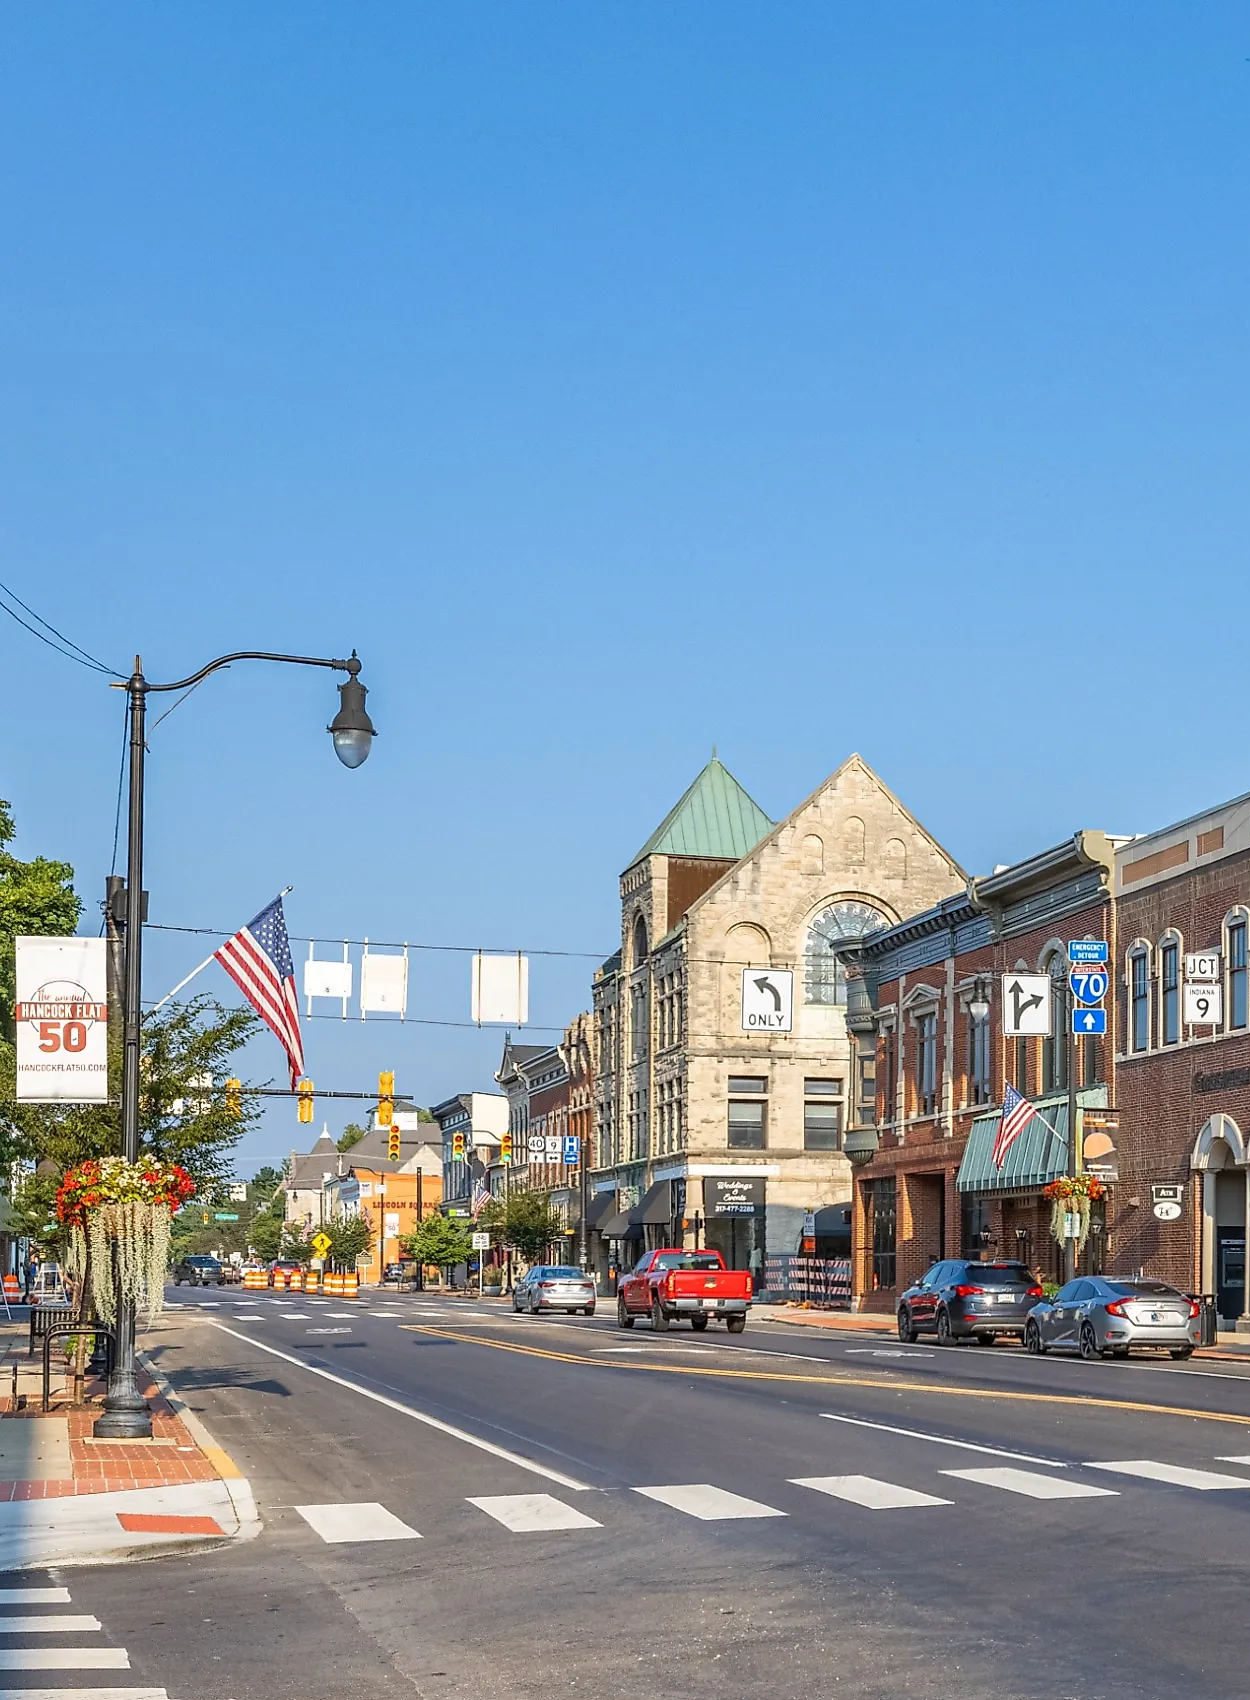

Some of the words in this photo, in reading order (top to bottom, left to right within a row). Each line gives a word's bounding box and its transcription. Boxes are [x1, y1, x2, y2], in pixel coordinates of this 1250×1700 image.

[1072, 943, 1105, 951] EMERGENCY
[1077, 952, 1099, 960] DETOUR
[1189, 958, 1216, 974] JCT
[1074, 974, 1104, 997] 70
[21, 1003, 72, 1018] HANCOCK
[76, 1003, 102, 1018] FLAT
[1196, 998, 1209, 1018] 9
[748, 1013, 784, 1026] ONLY
[38, 1022, 87, 1053] 50
[18, 1064, 107, 1072] HANCOCKFLAT50.COM
[530, 1139, 543, 1148] 40
[551, 1142, 557, 1150] 9
[717, 1181, 754, 1190] Weddings
[723, 1193, 747, 1201] Events
